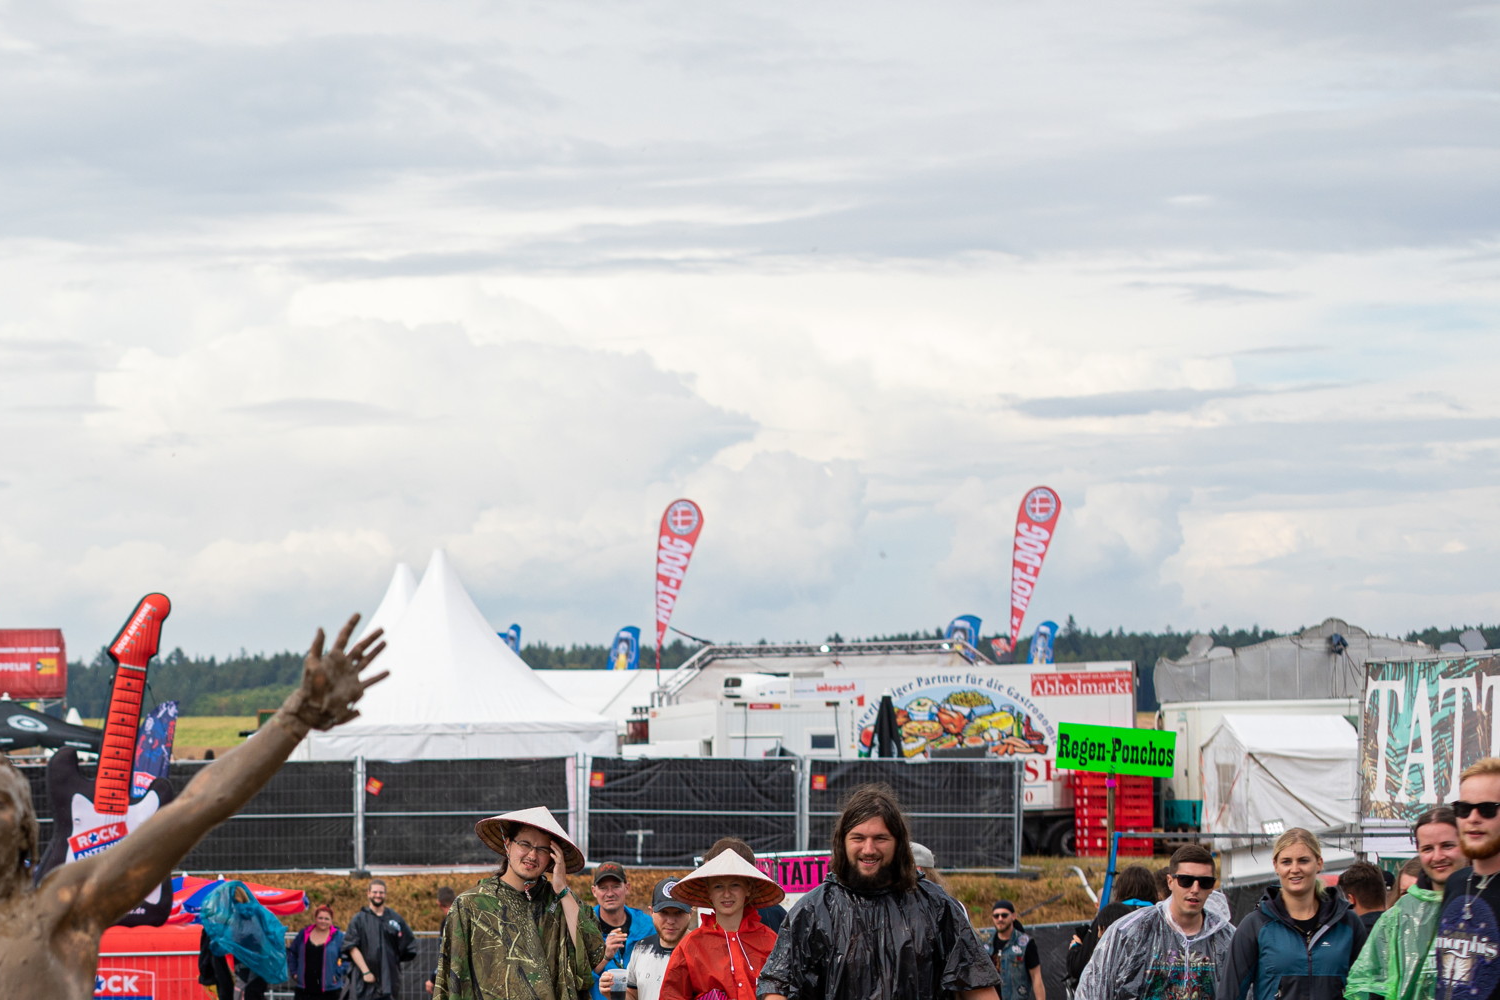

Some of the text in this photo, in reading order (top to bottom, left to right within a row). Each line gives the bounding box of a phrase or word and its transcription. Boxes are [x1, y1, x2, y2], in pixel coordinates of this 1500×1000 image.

[657, 535, 693, 626] HOT-DOG
[1012, 521, 1050, 612] HOT-DOG
[114, 602, 153, 655] ROCK ANTENNE
[916, 674, 962, 688] Partner
[965, 673, 984, 686] für
[986, 677, 1005, 692] die
[1033, 676, 1131, 696] Abholmarkt
[1058, 732, 1175, 768] Regen-Ponchos
[76, 824, 120, 849] ROCK
